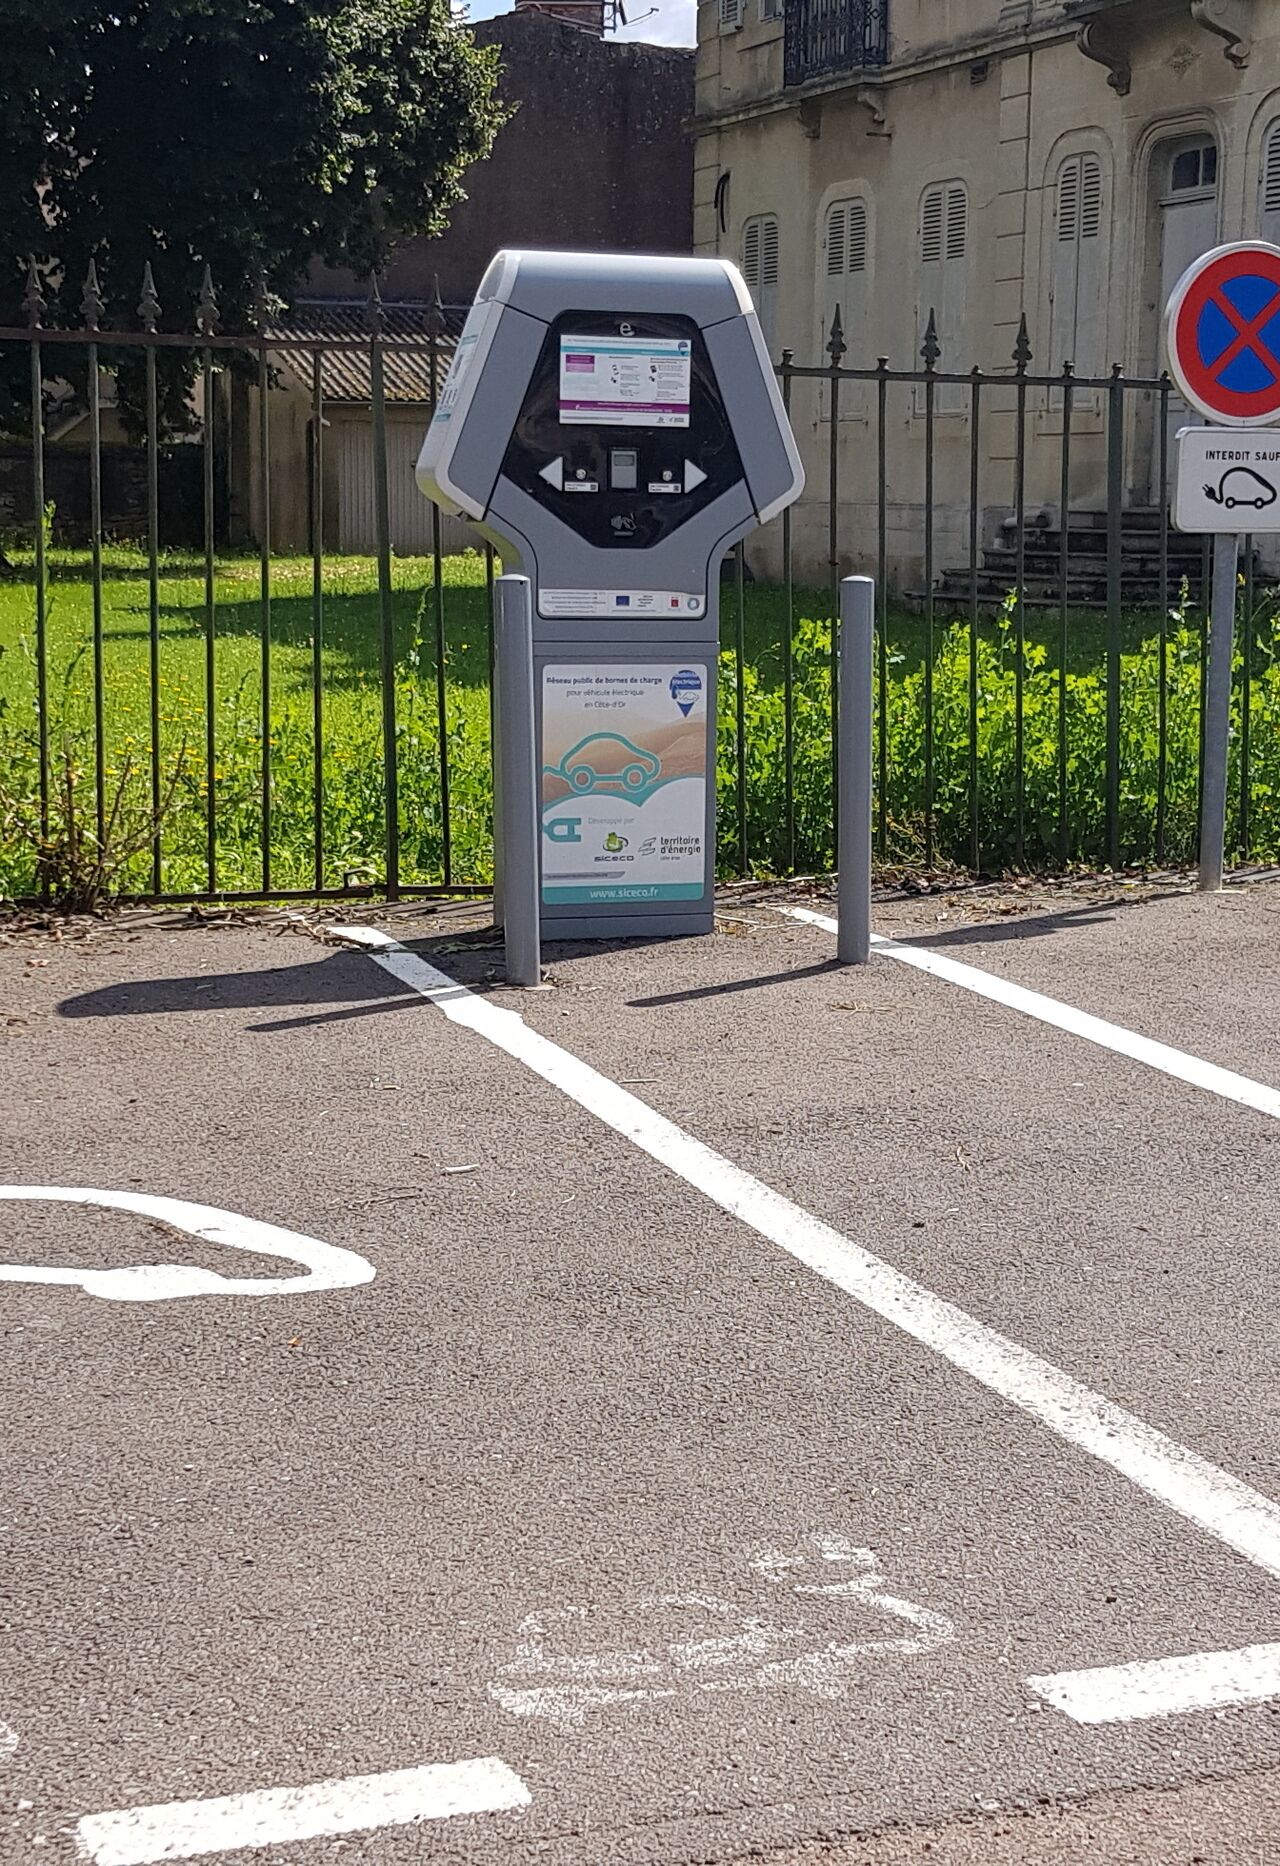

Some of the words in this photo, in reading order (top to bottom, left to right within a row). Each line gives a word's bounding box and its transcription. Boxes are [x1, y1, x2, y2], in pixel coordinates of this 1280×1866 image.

[1205, 450, 1250, 461] INTERDIT
[546, 676, 571, 684] Réseau
[573, 676, 593, 685] public
[595, 676, 603, 684] de
[605, 676, 628, 684] bornes
[630, 676, 638, 684] de
[640, 676, 662, 685] charge
[660, 836, 700, 845] territoire
[660, 845, 701, 855] d'énergie
[589, 886, 659, 899] www.siceco.fr
